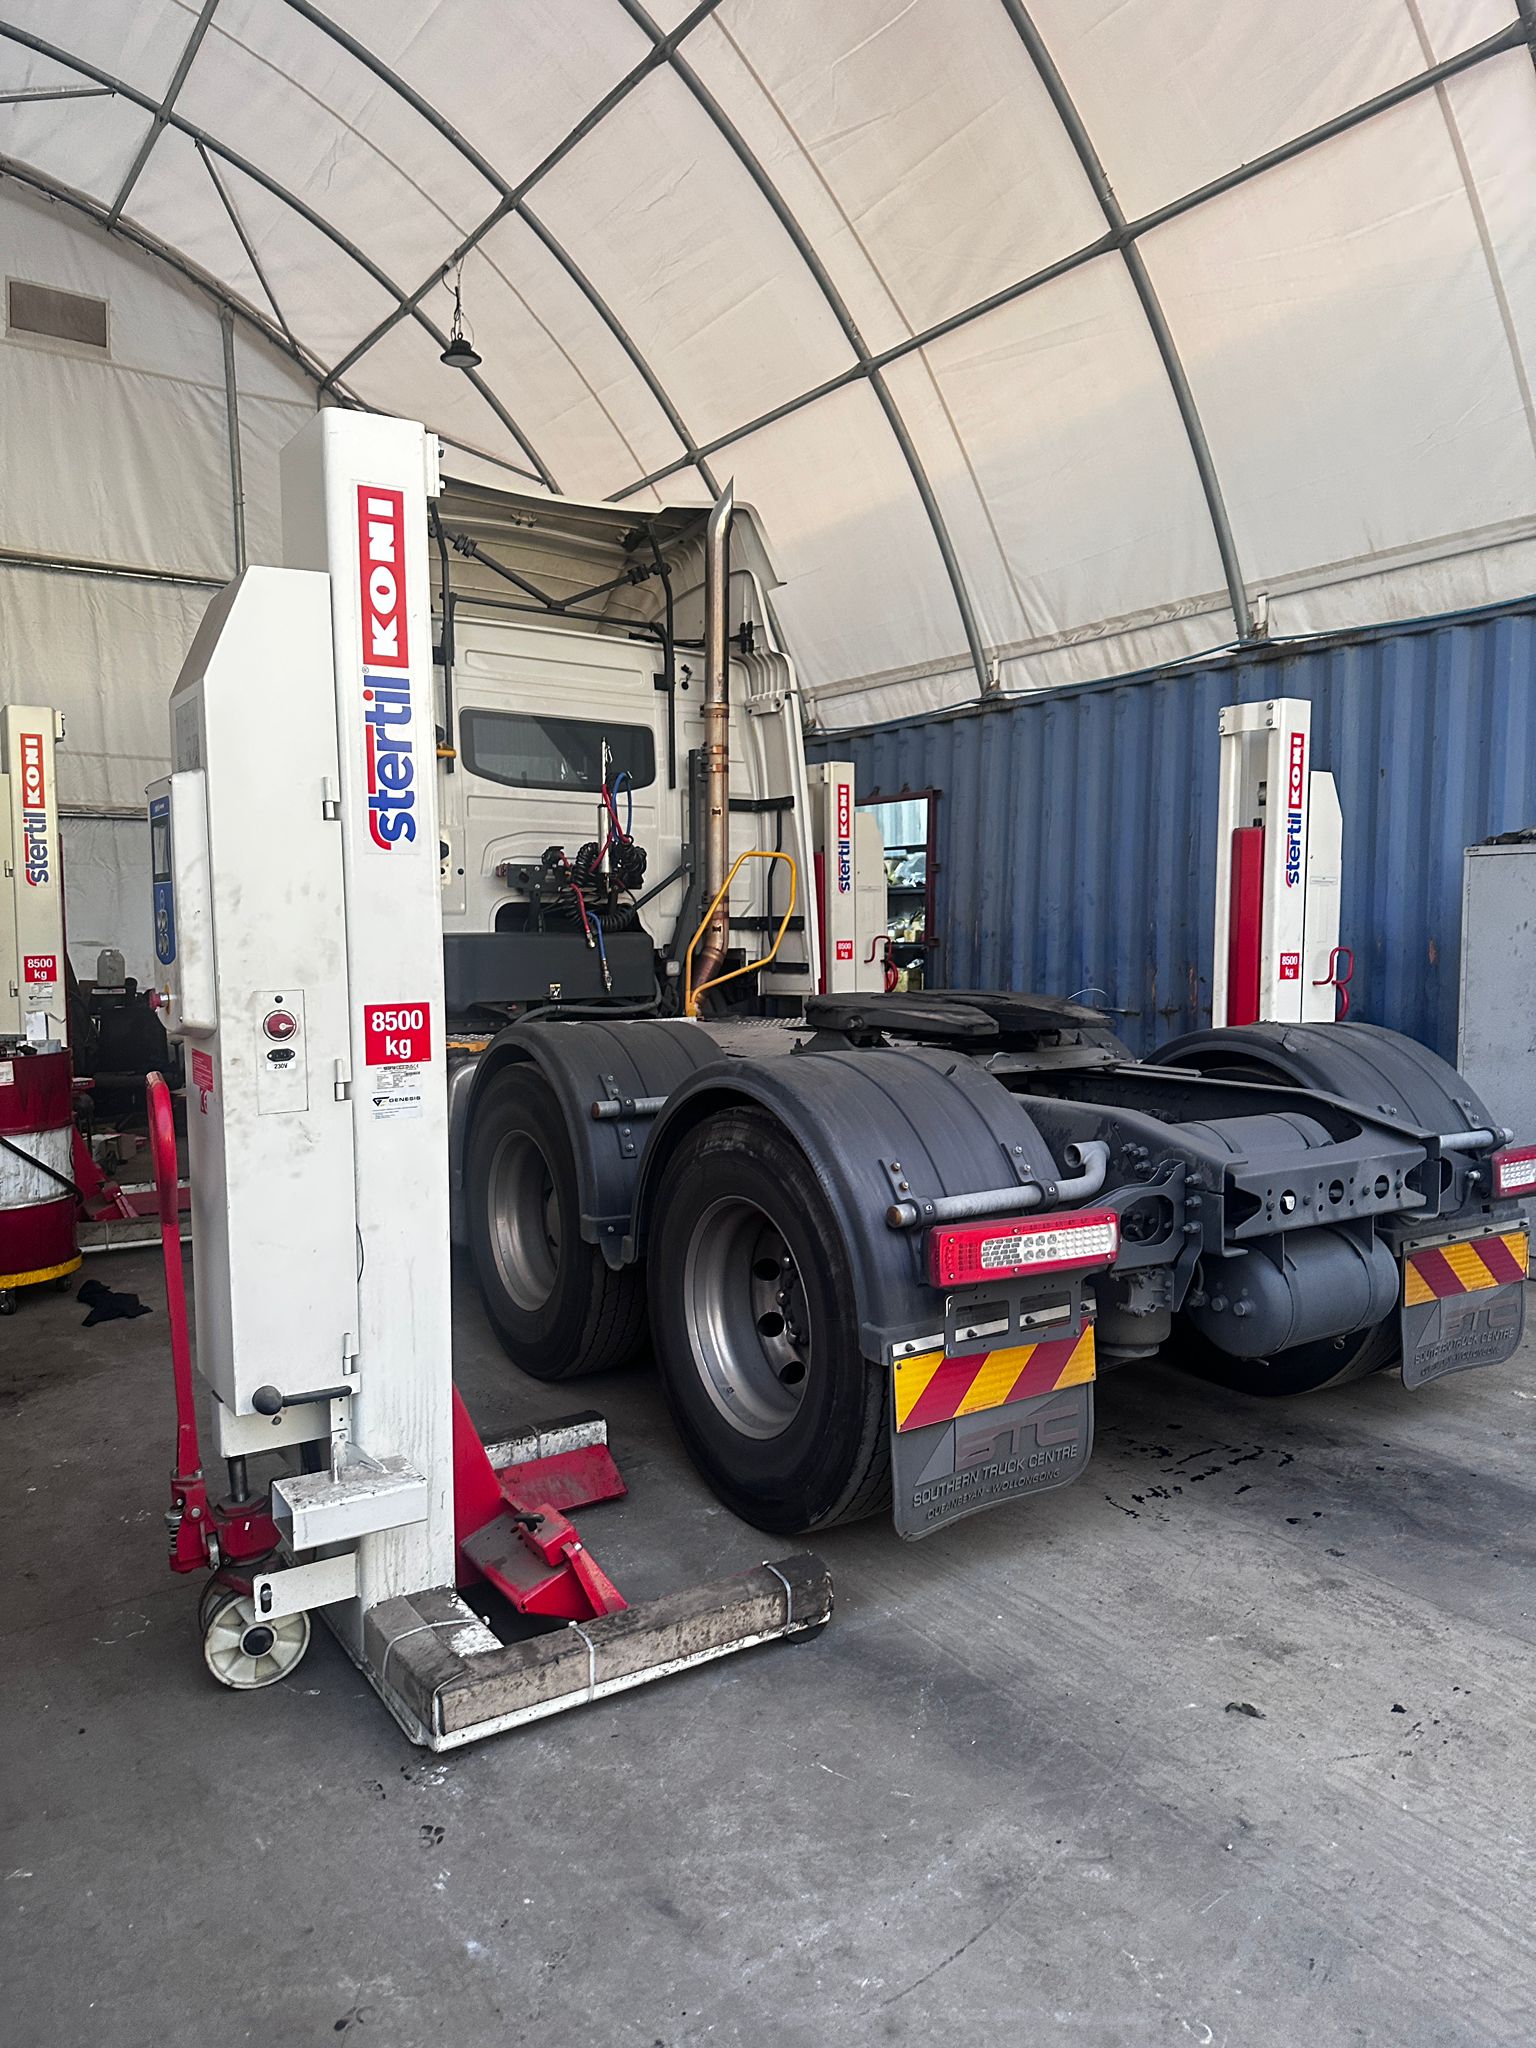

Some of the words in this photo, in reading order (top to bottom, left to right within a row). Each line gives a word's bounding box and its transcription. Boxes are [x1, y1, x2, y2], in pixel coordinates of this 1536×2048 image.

[367, 497, 399, 657] KONI
[25, 738, 41, 805] KONI
[363, 674, 417, 850] stertil
[1290, 736, 1303, 805] KONI
[839, 787, 848, 836] KONI
[23, 812, 49, 887] stertil
[838, 840, 850, 894] stertil
[1286, 812, 1302, 888] stertil
[27, 958, 53, 968] 8500
[34, 970, 48, 980] kg
[1281, 955, 1298, 965] 8500
[1285, 966, 1294, 978] kg
[371, 1009, 424, 1032] 8500
[273, 1062, 288, 1070] 230V
[385, 1035, 412, 1060] kg
[388, 1095, 421, 1103] GENESIS
[1480, 1327, 1515, 1345] CENTRE
[955, 1403, 1080, 1473] STC
[913, 1471, 979, 1508] SOUTHERN
[983, 1459, 1025, 1480] TRUCK
[1028, 1444, 1079, 1469] CENTRE
[927, 1488, 984, 1520] QUEANBEYAN
[991, 1468, 1061, 1494] WOLLONGONG
